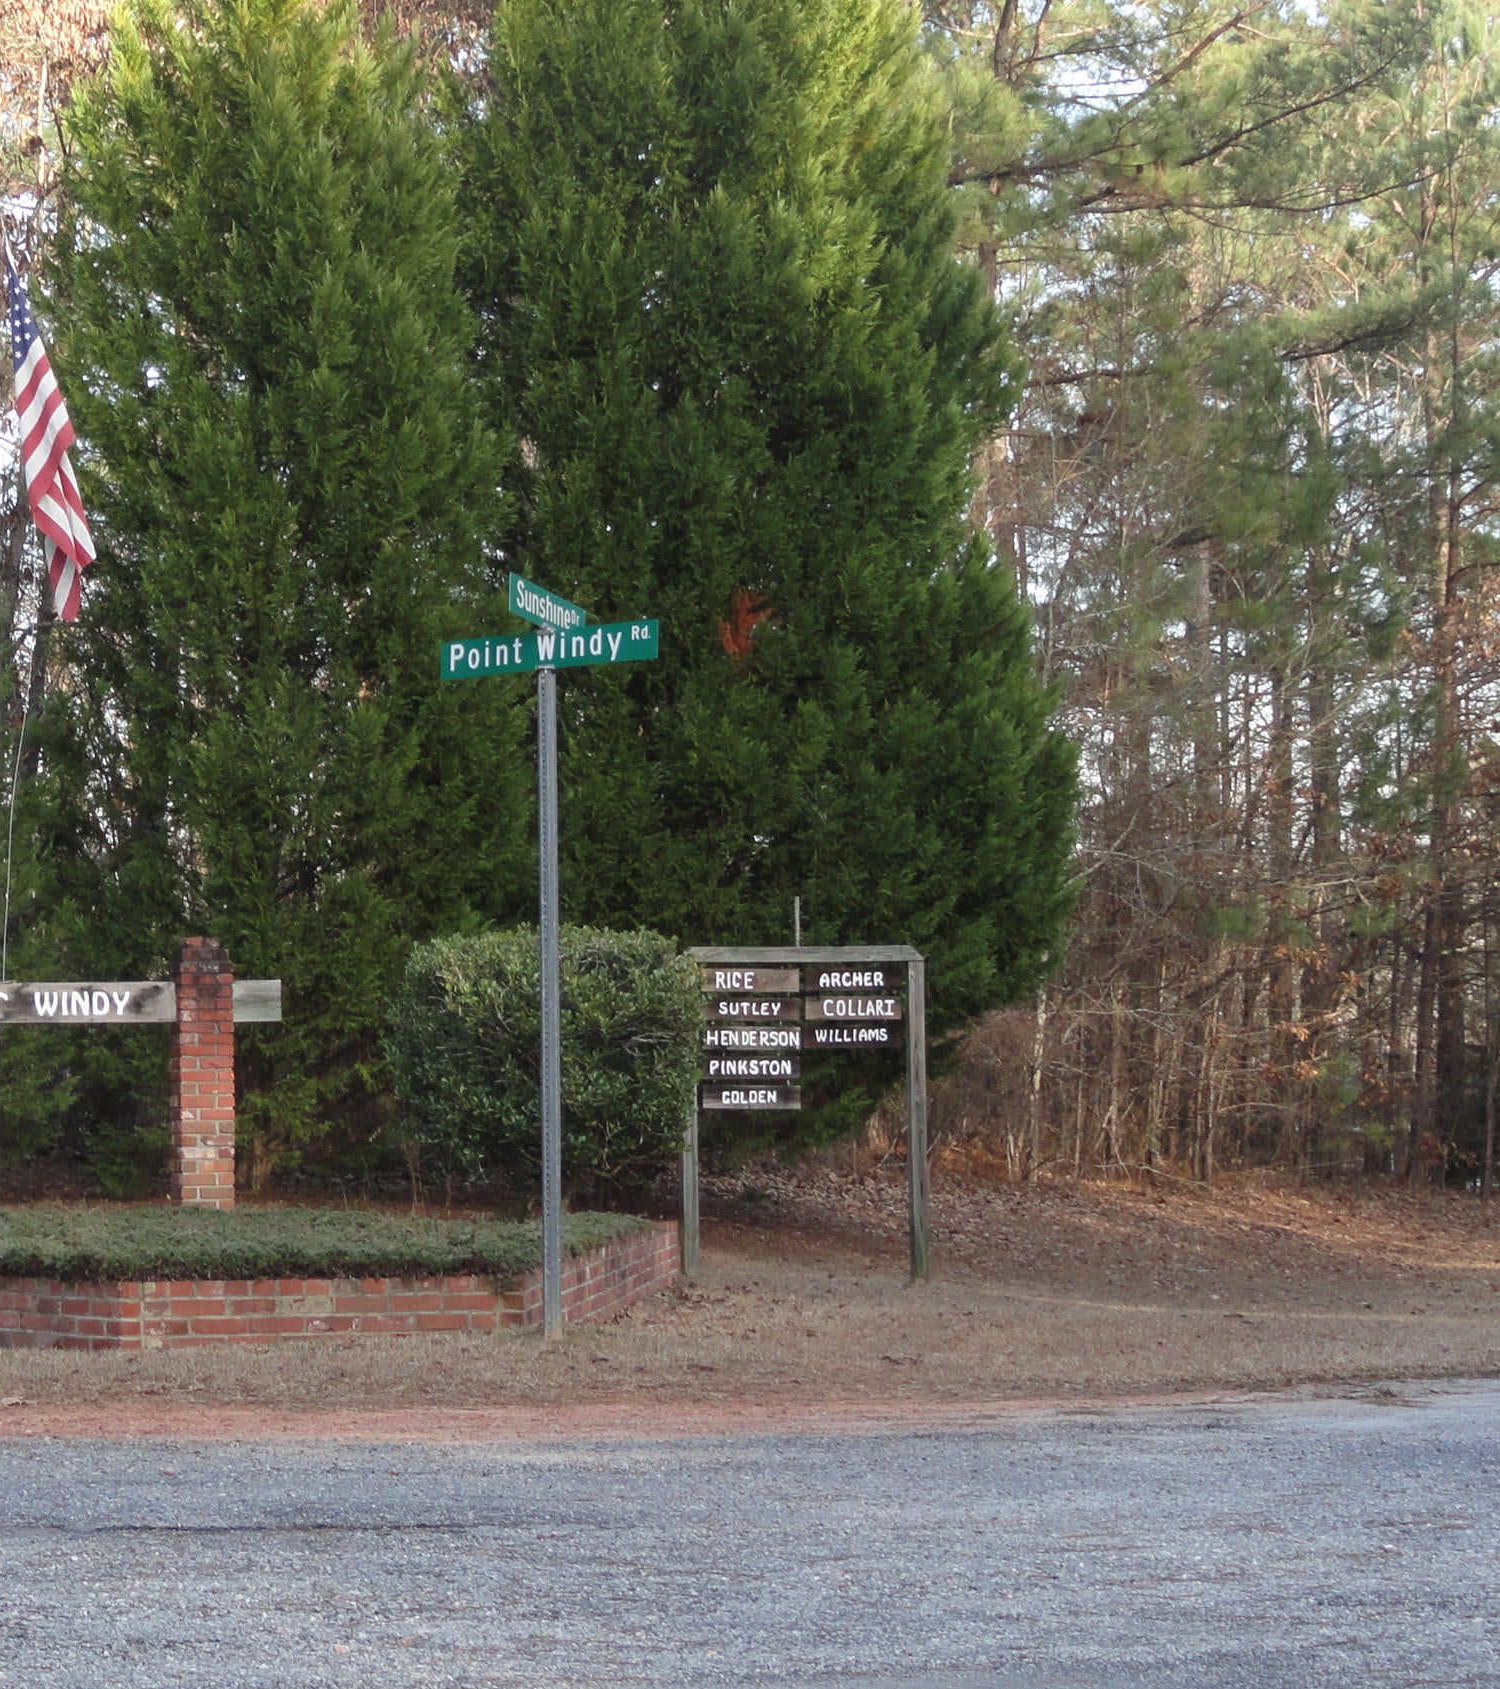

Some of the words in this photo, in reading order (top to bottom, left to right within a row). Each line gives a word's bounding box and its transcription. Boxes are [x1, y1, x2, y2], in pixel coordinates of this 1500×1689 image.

[515, 579, 571, 630] Sunshine
[449, 637, 522, 672] Point
[536, 627, 622, 661] Windy
[714, 971, 755, 990] RICE
[819, 971, 885, 988] ARCHER
[33, 990, 131, 1017] WINDY
[718, 1001, 781, 1016] SUTLEY
[706, 1030, 800, 1049] HENDERSON
[815, 1028, 888, 1043] WILLIAMS
[709, 1059, 792, 1076] PINKSTON
[721, 1090, 777, 1105] GOLDEN
